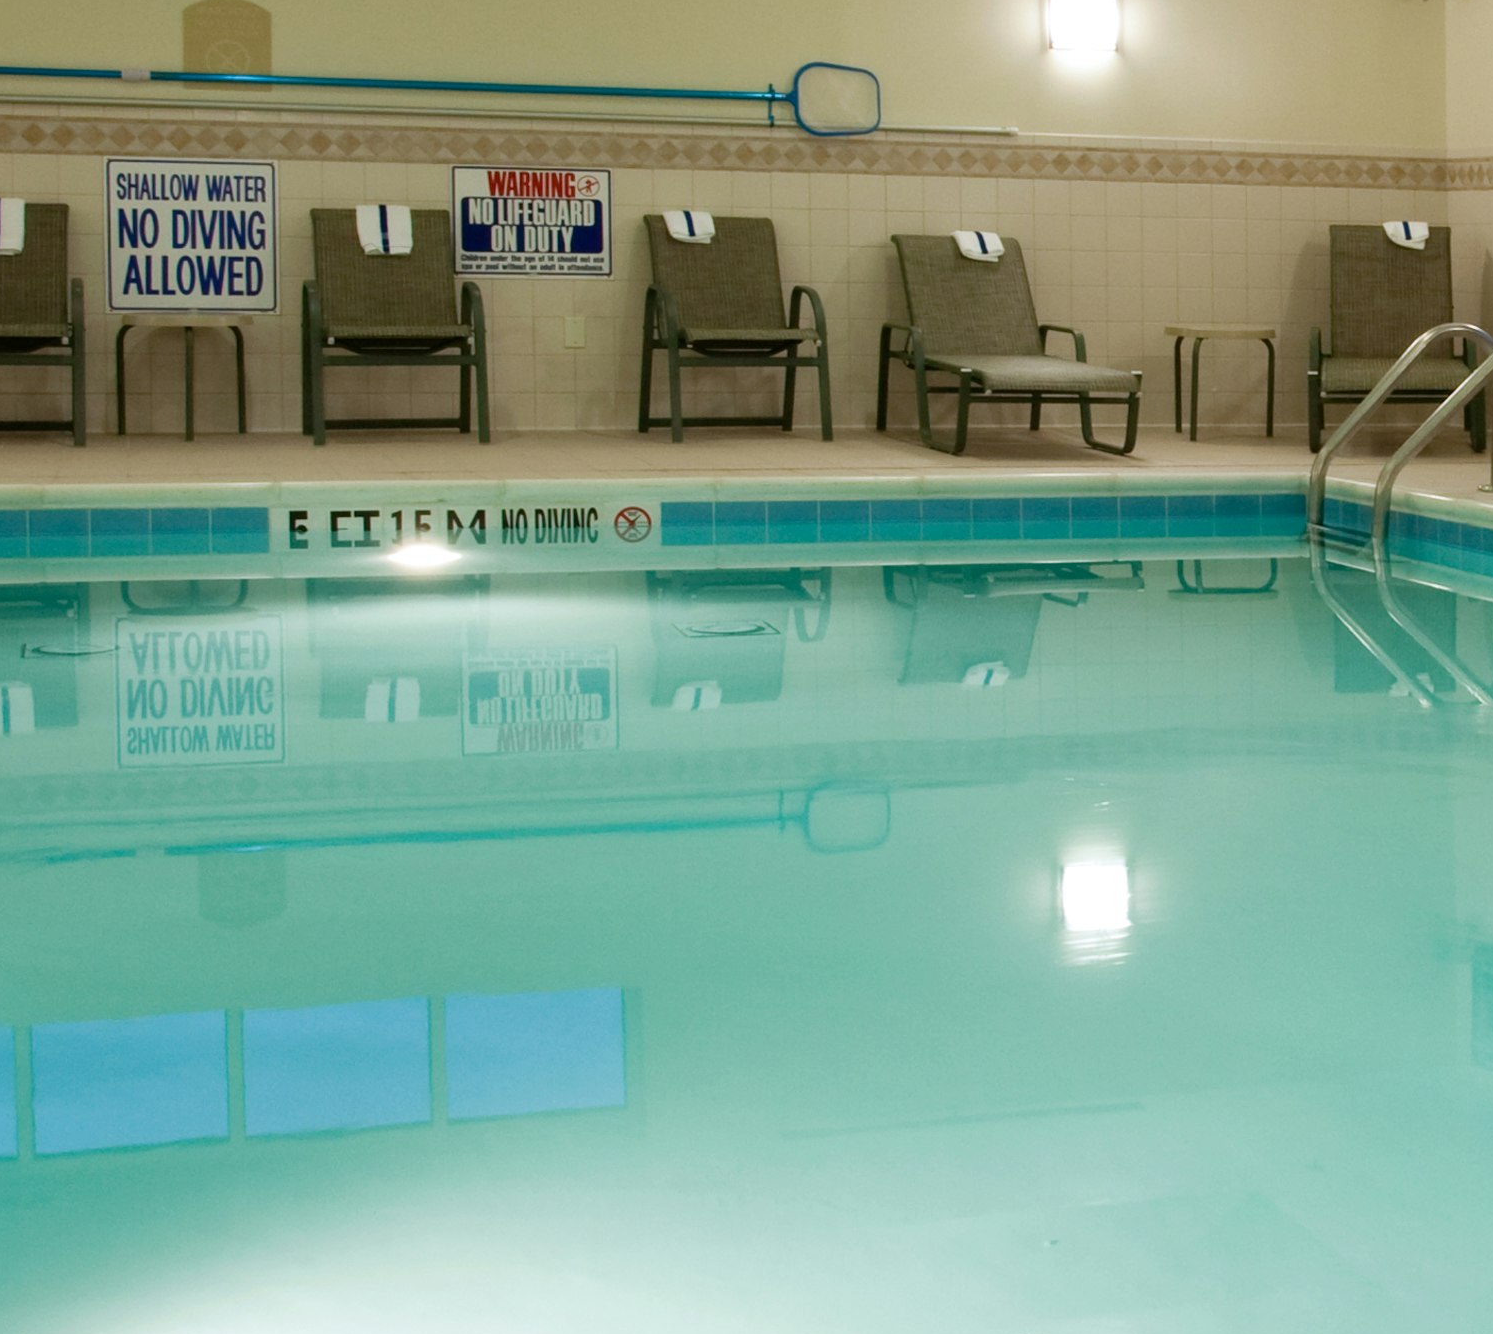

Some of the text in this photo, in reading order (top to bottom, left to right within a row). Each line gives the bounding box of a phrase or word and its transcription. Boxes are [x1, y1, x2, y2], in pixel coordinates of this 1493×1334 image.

[116, 172, 267, 203] SHALLOW WATER
[487, 170, 576, 199] WARNING
[467, 197, 596, 227] NO LIFEGUARD
[117, 207, 267, 251] NO DIVING
[490, 224, 574, 253] ON DUTY
[122, 254, 264, 297] ALLOWED
[500, 507, 529, 531] NO
